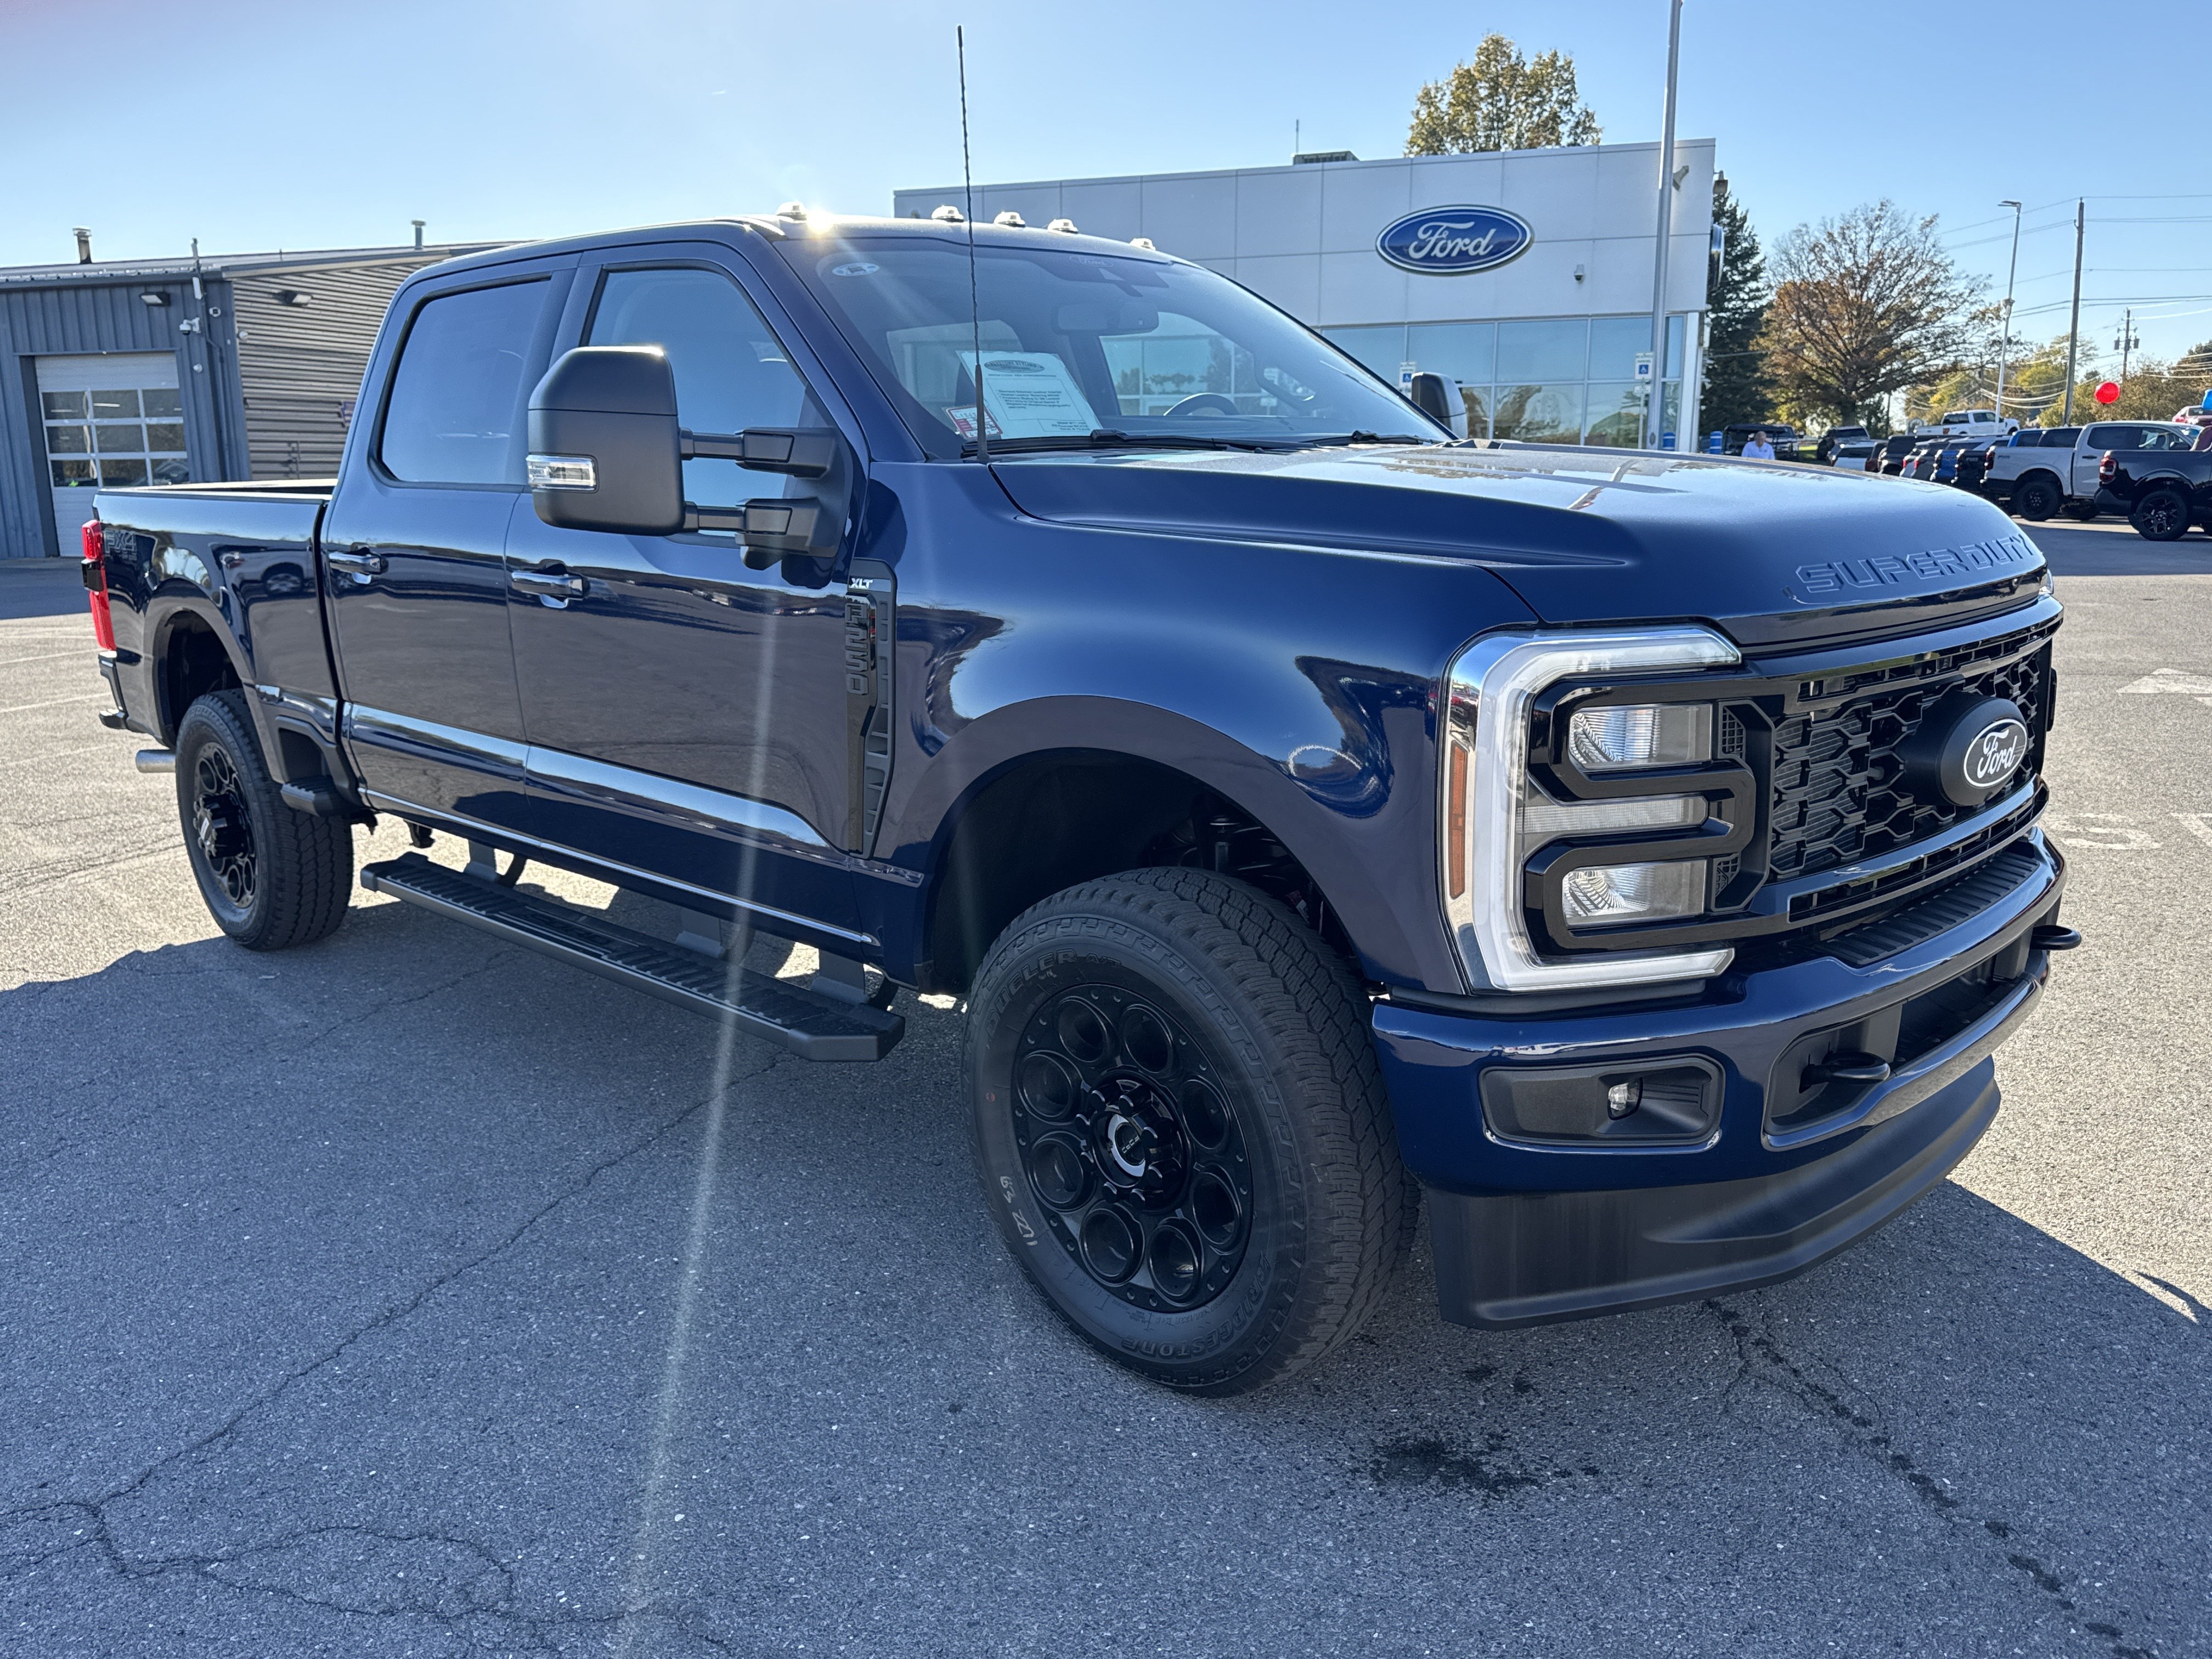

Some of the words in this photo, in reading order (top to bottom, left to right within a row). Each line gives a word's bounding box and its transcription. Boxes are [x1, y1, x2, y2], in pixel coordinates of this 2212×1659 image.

[1408, 221, 1497, 259] Ford
[104, 529, 137, 555] FX4
[1796, 548, 1970, 594] SUPER
[1959, 533, 2035, 571] DUTY
[849, 577, 873, 590] XLT
[1977, 728, 2017, 779] Ford
[986, 948, 1077, 1039] DUELER
[1121, 1251, 1272, 1359] BRIDGESTONE
